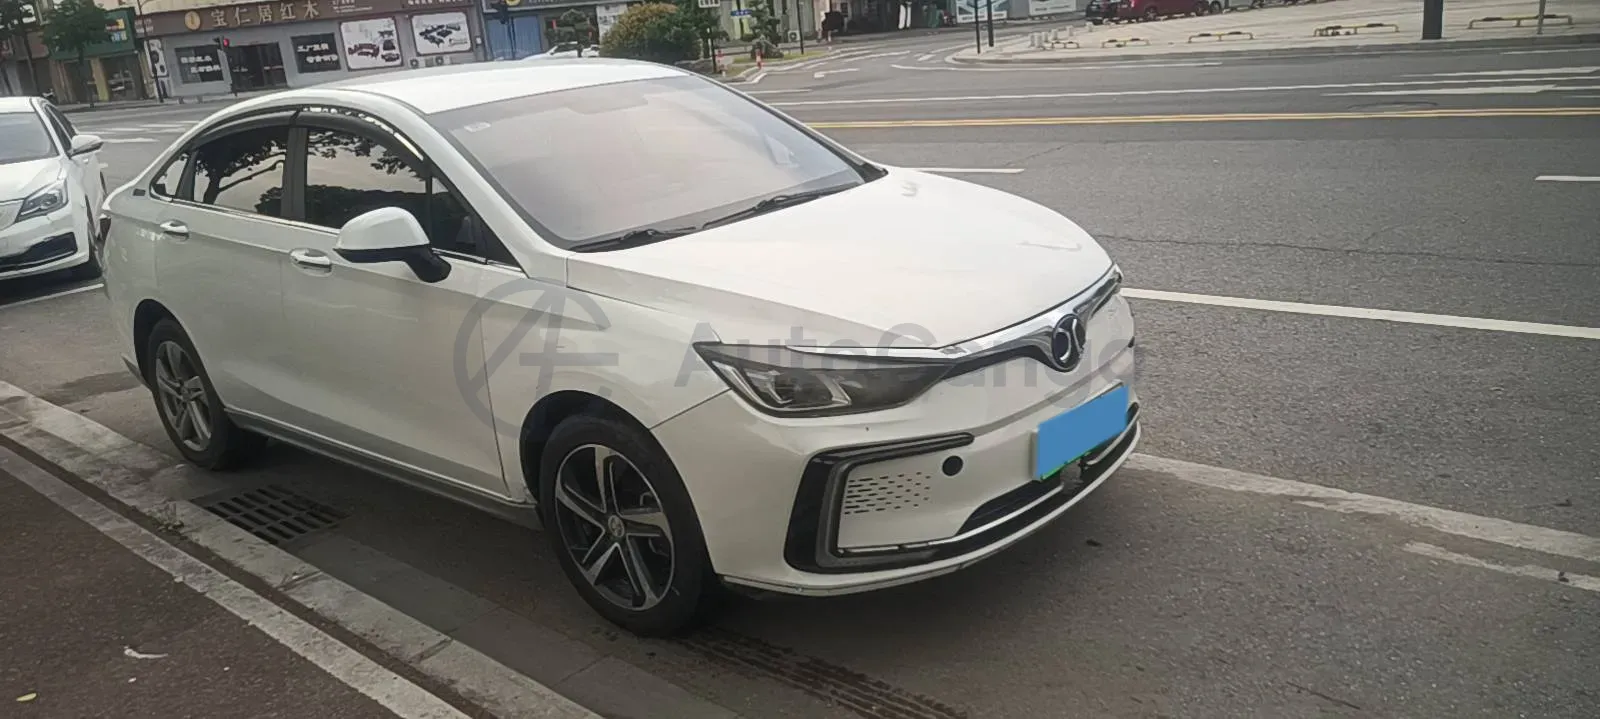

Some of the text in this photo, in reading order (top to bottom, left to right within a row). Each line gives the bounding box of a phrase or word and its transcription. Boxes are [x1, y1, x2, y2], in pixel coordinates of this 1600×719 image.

[210, 0, 320, 27] 宝仁居红木
